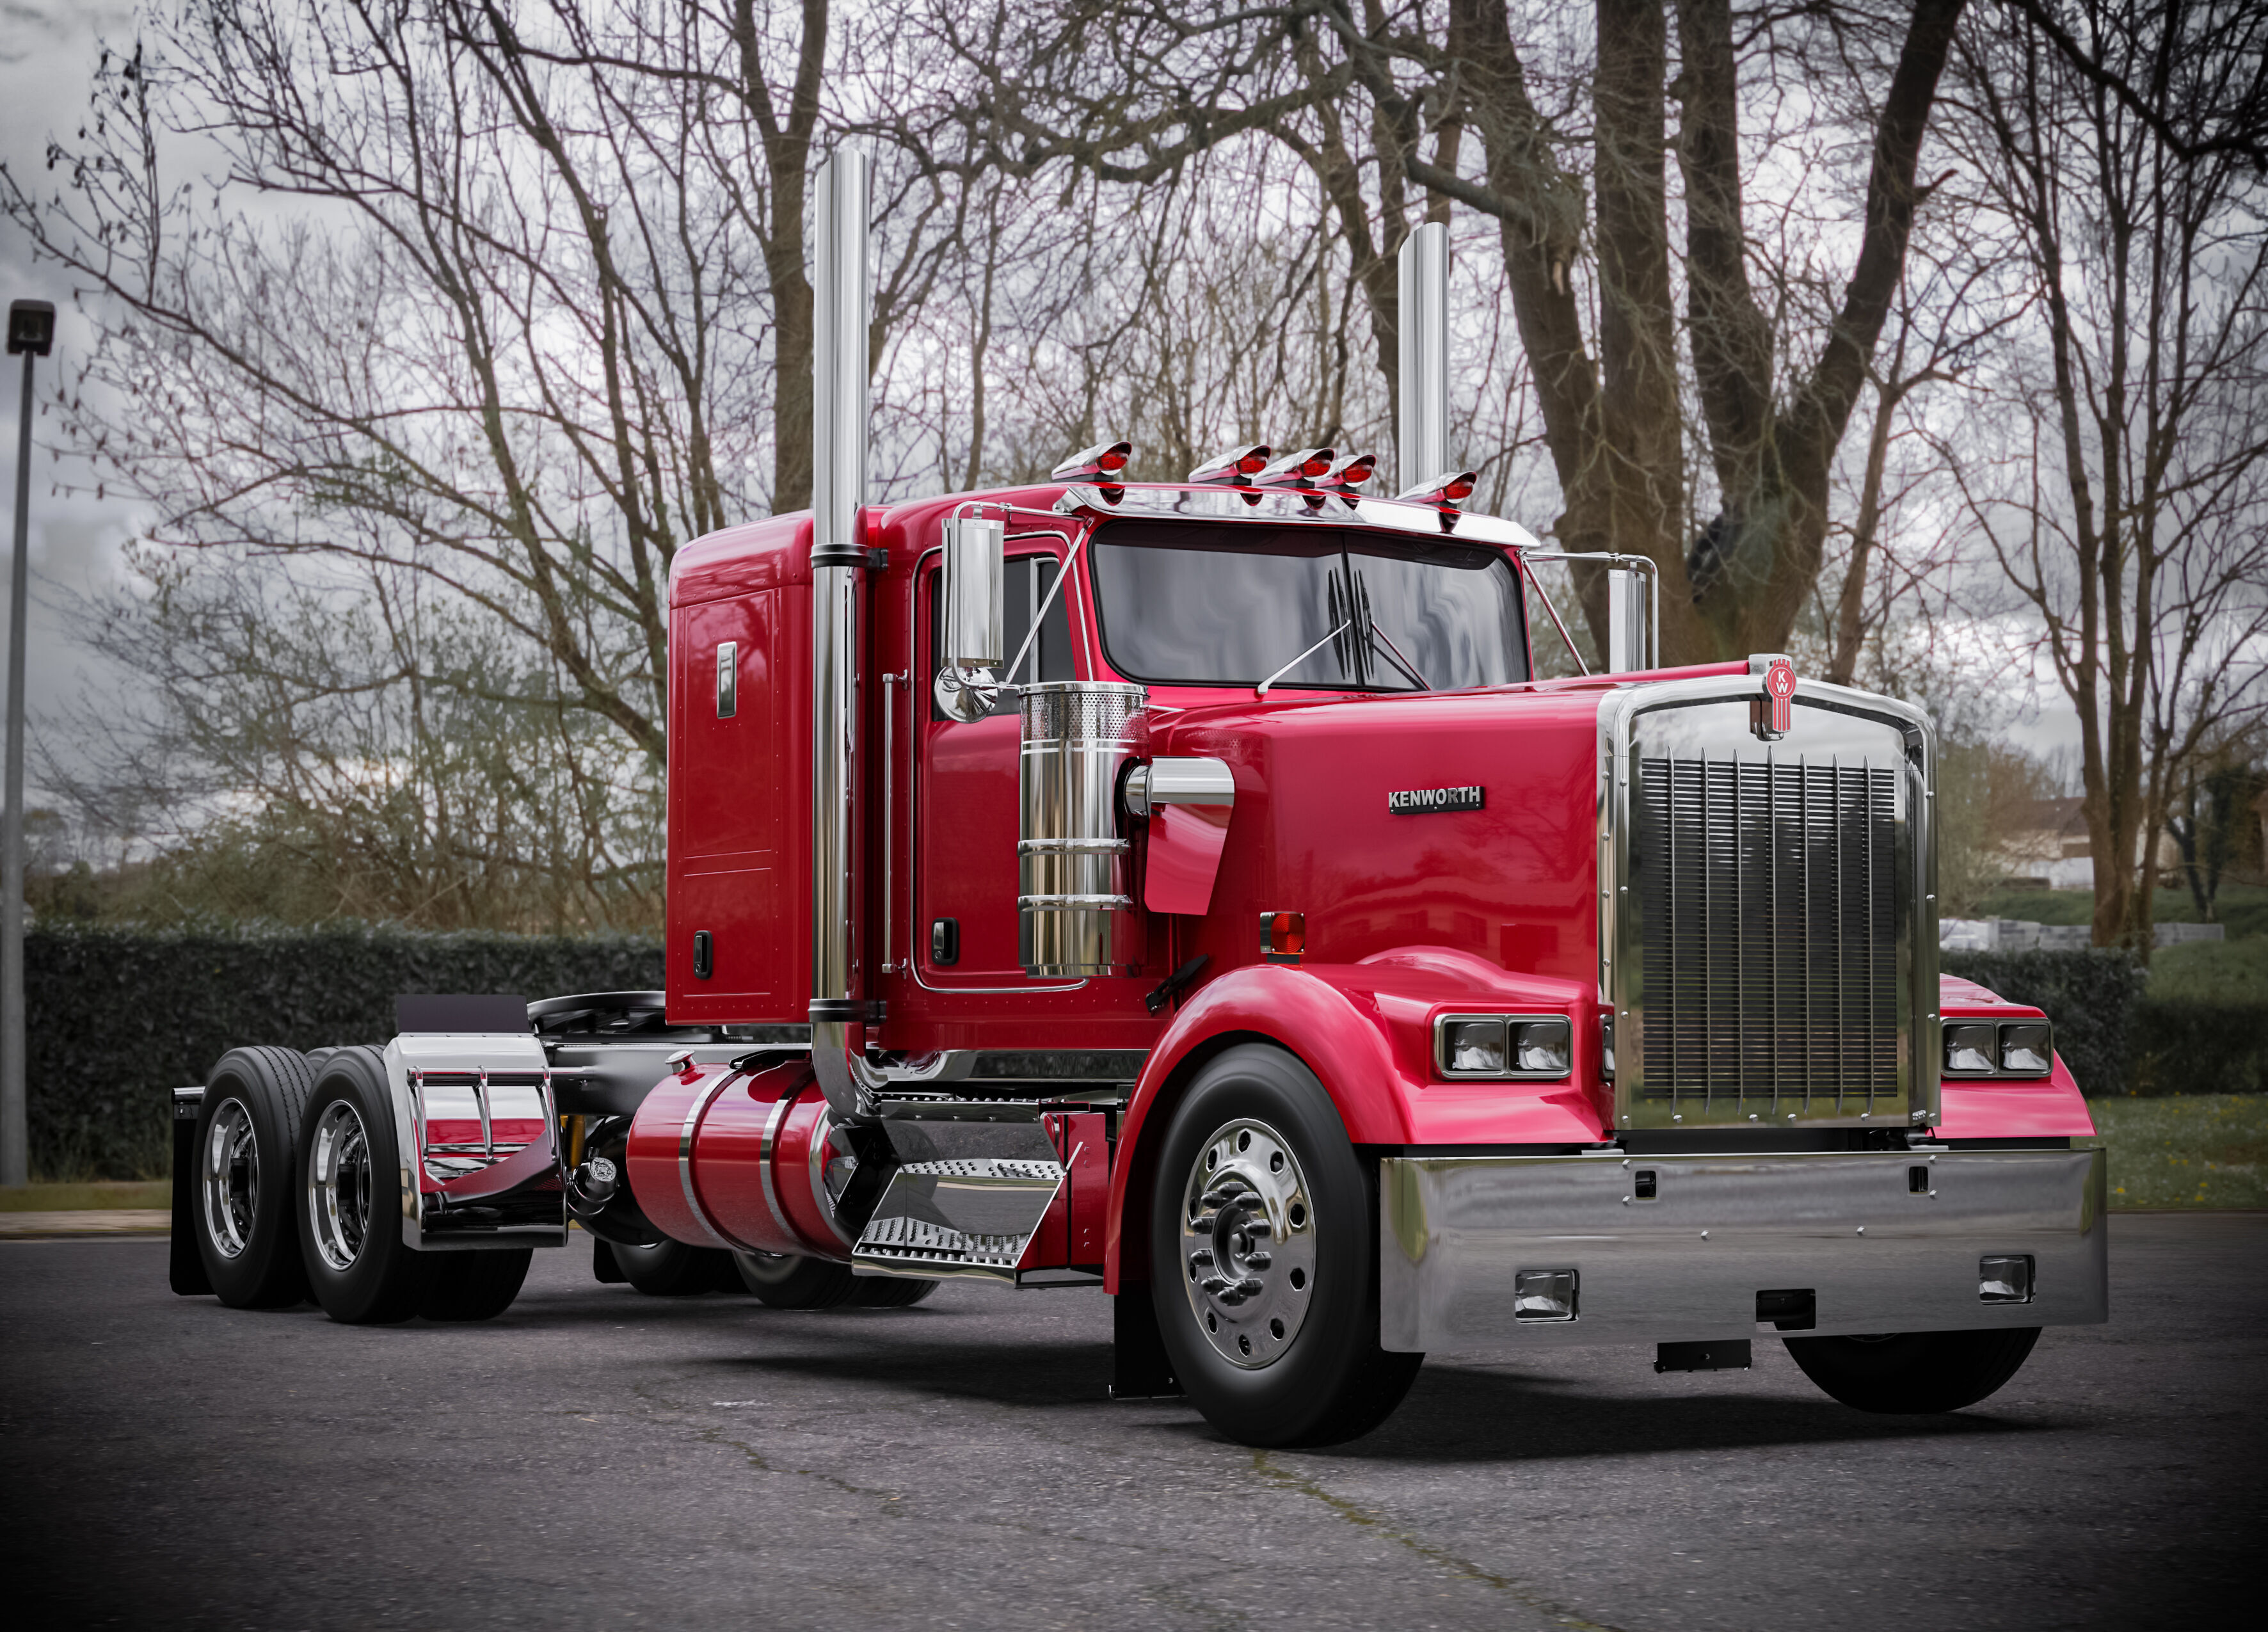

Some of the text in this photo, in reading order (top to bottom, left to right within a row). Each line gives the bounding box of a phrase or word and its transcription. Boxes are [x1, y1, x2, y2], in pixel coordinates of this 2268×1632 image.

[1778, 671, 1786, 682] K
[1775, 682, 1789, 693] W
[1388, 786, 1480, 808] KENWORTH
